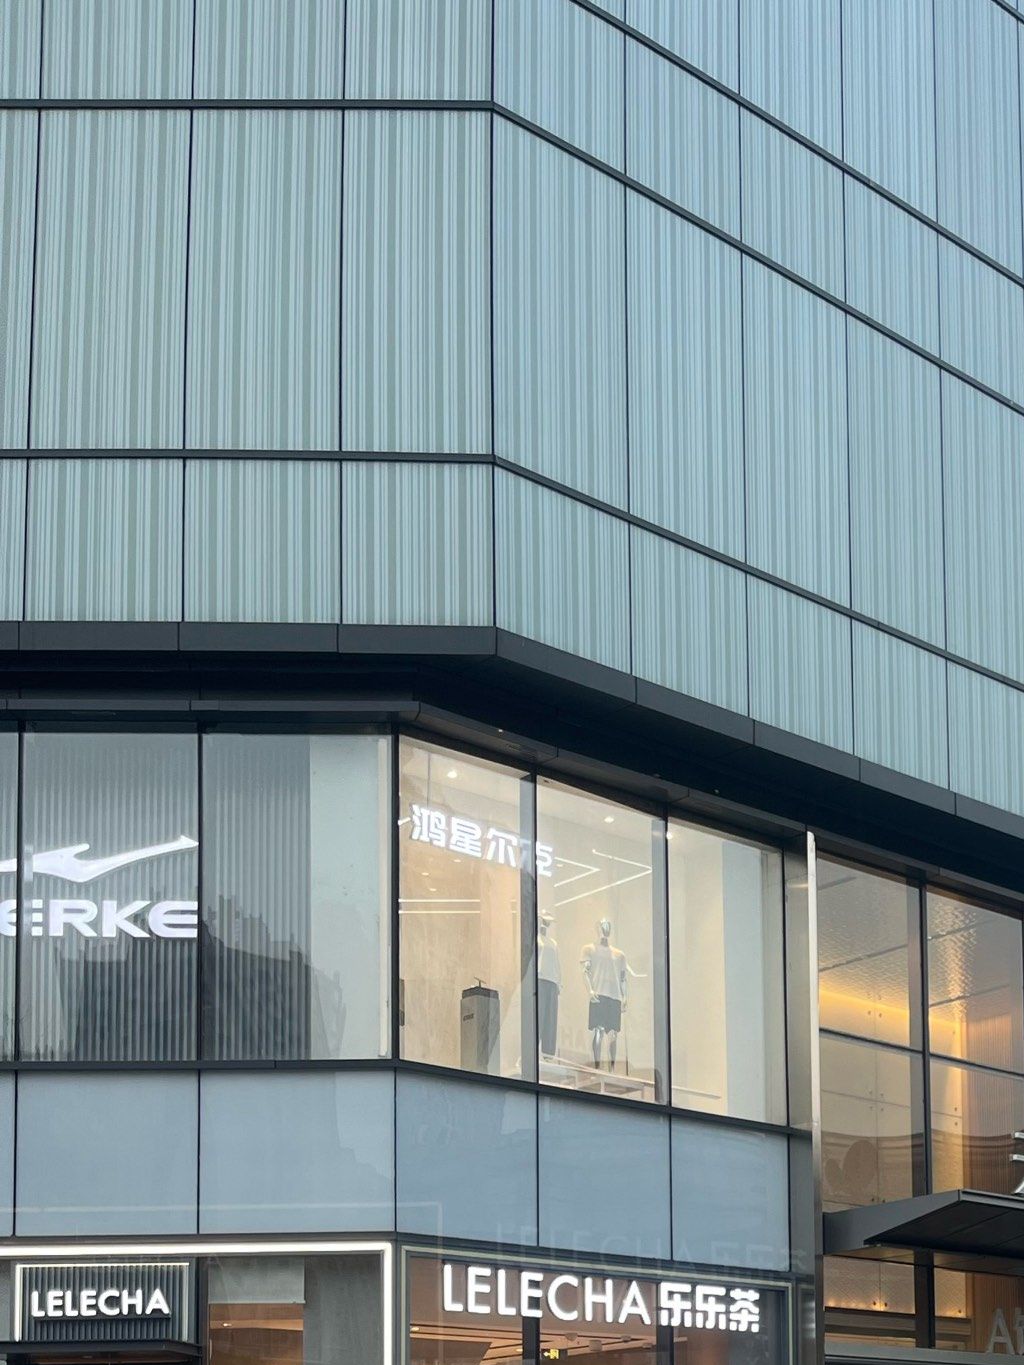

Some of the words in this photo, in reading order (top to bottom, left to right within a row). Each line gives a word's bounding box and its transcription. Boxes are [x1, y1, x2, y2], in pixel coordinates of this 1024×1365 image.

[30, 1287, 171, 1318] LELECHA
[442, 1263, 652, 1326] LELECHA
[659, 1281, 761, 1333] 乐乐茶
